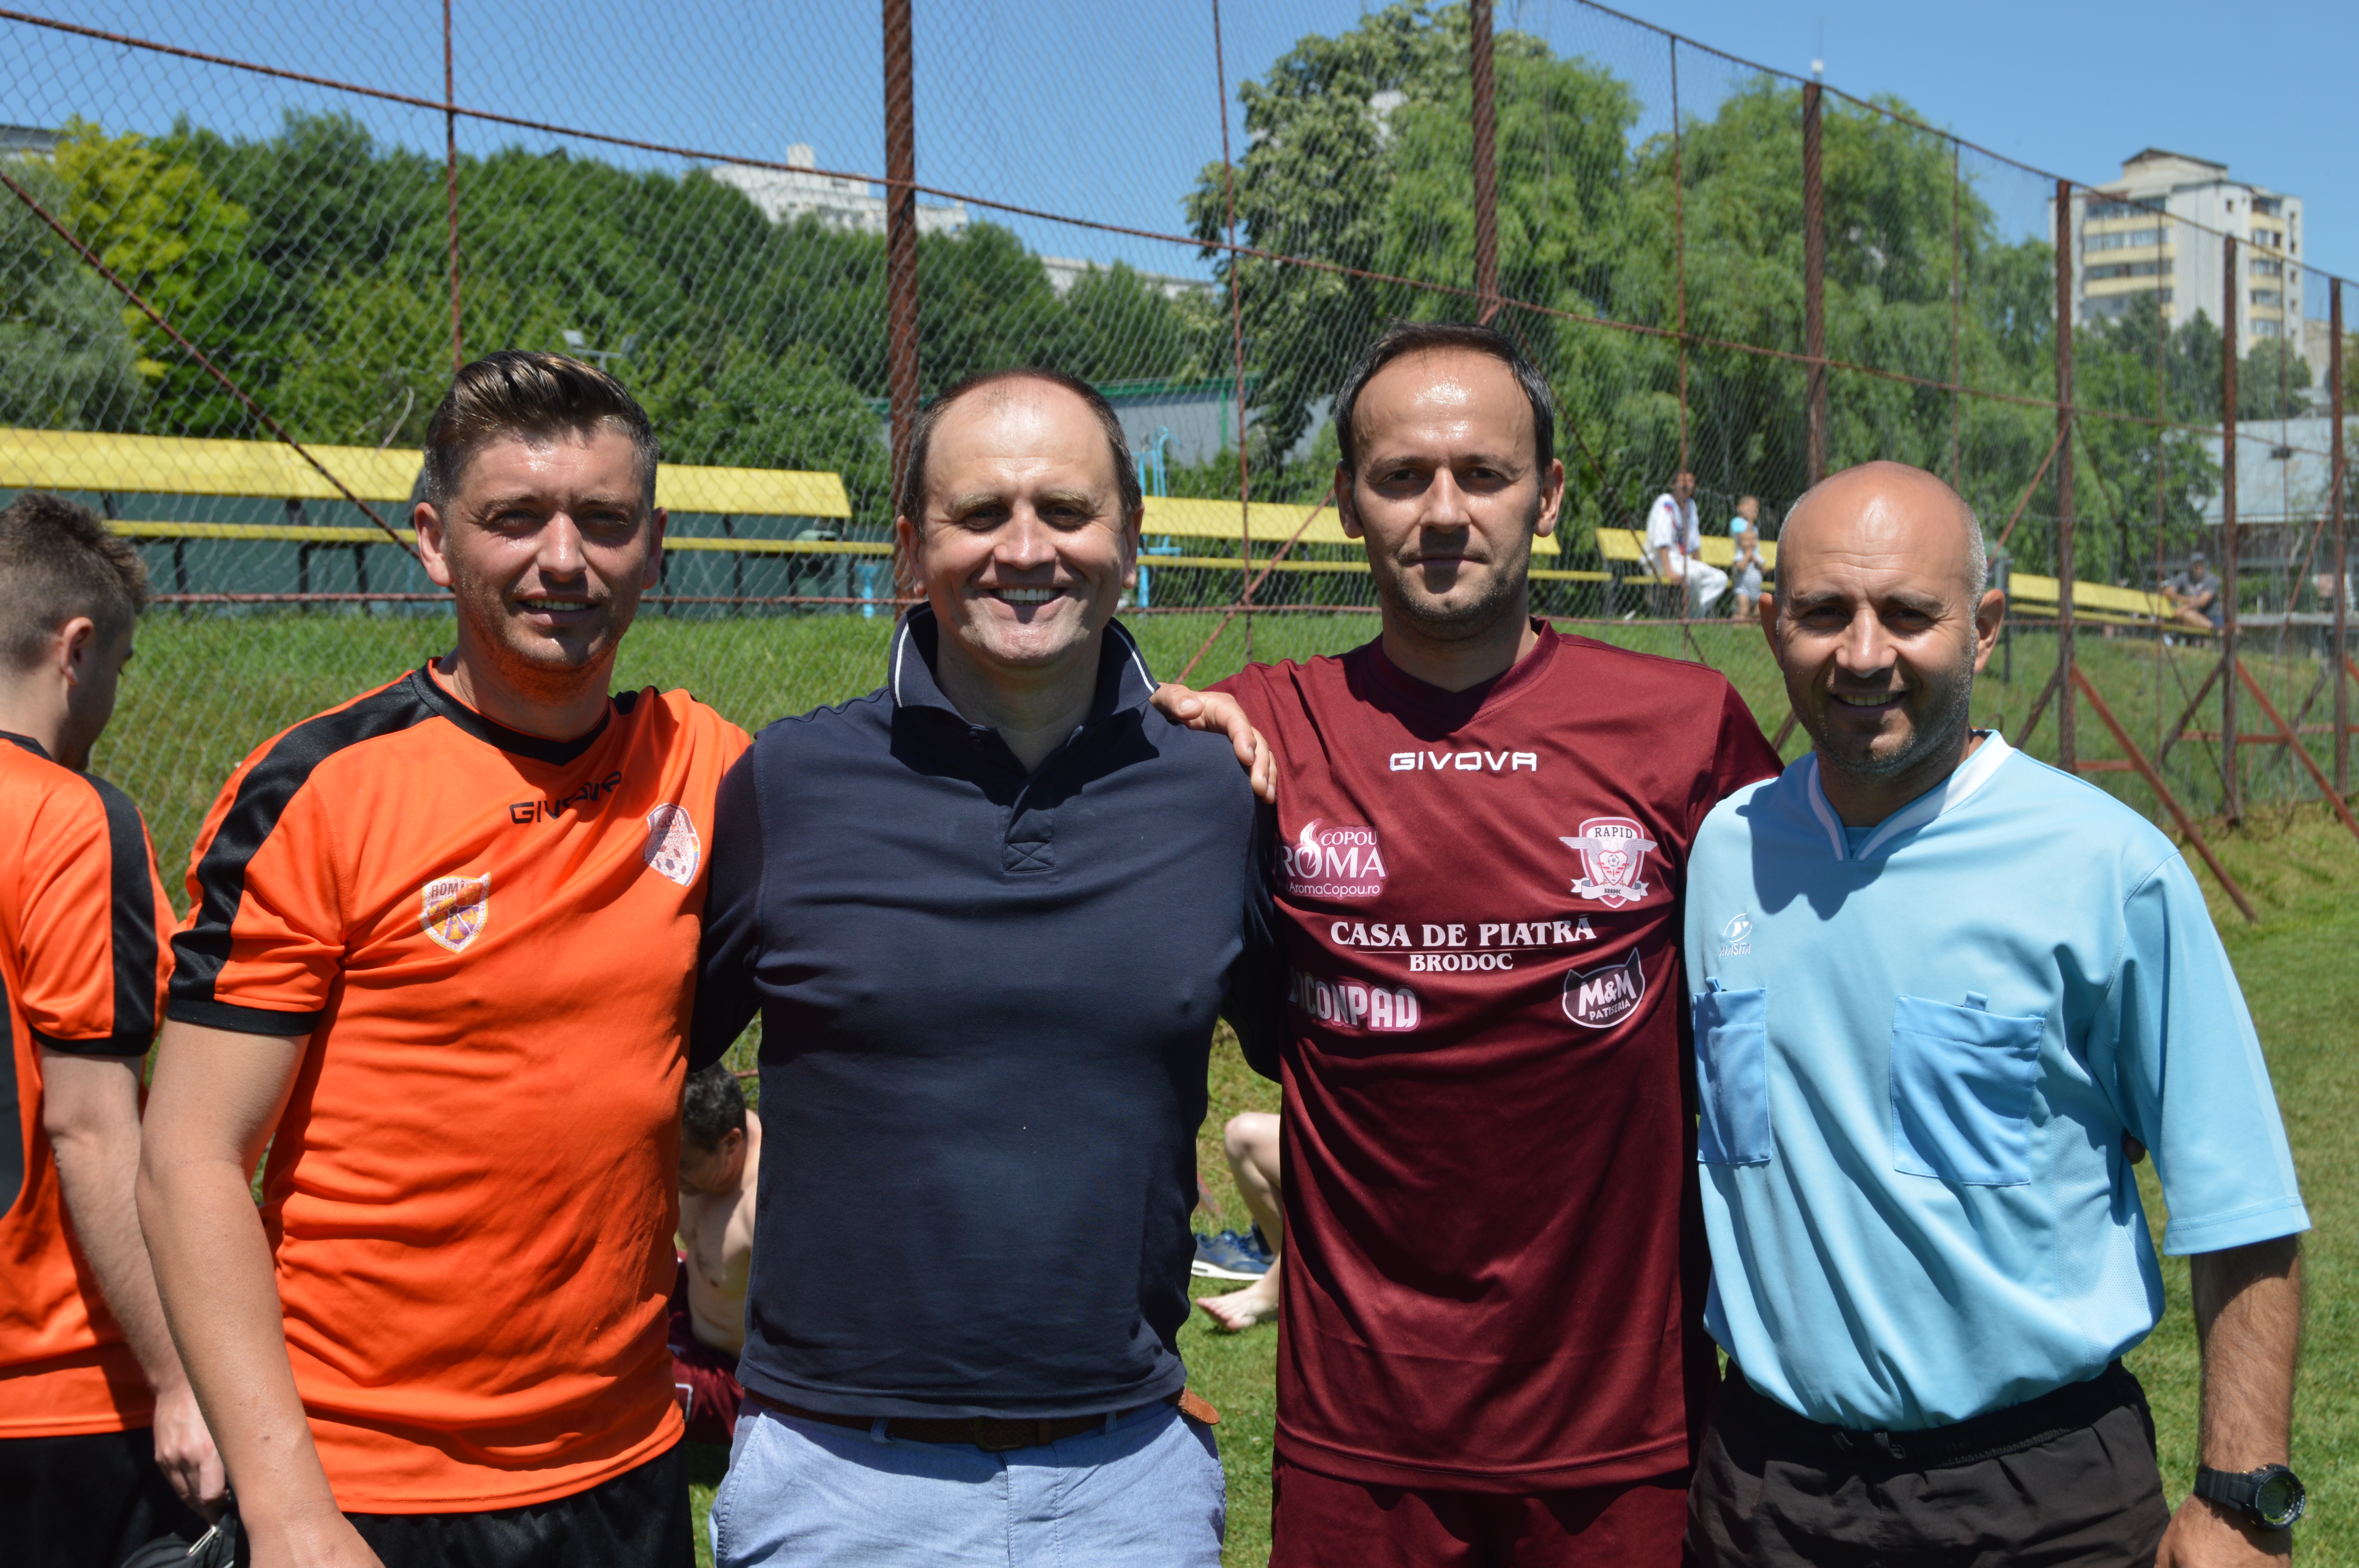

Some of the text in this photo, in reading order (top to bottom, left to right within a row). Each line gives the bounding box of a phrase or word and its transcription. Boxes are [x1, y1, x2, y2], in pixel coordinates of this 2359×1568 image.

[1390, 751, 1537, 771] GIVOVA
[509, 771, 622, 824] GIVOVA
[1321, 831, 1377, 846] COPOU
[1594, 827, 1633, 838] RAPID
[1275, 846, 1386, 878] AROMA
[1277, 880, 1380, 897] ww.AromaCopou.ro
[1331, 922, 1412, 946] CASA
[1422, 924, 1468, 946] DE
[1717, 943, 1751, 958] MASITA
[1410, 953, 1514, 972] BRODOC
[1578, 969, 1637, 1017] M&M
[1589, 999, 1631, 1021] PATISERIA
